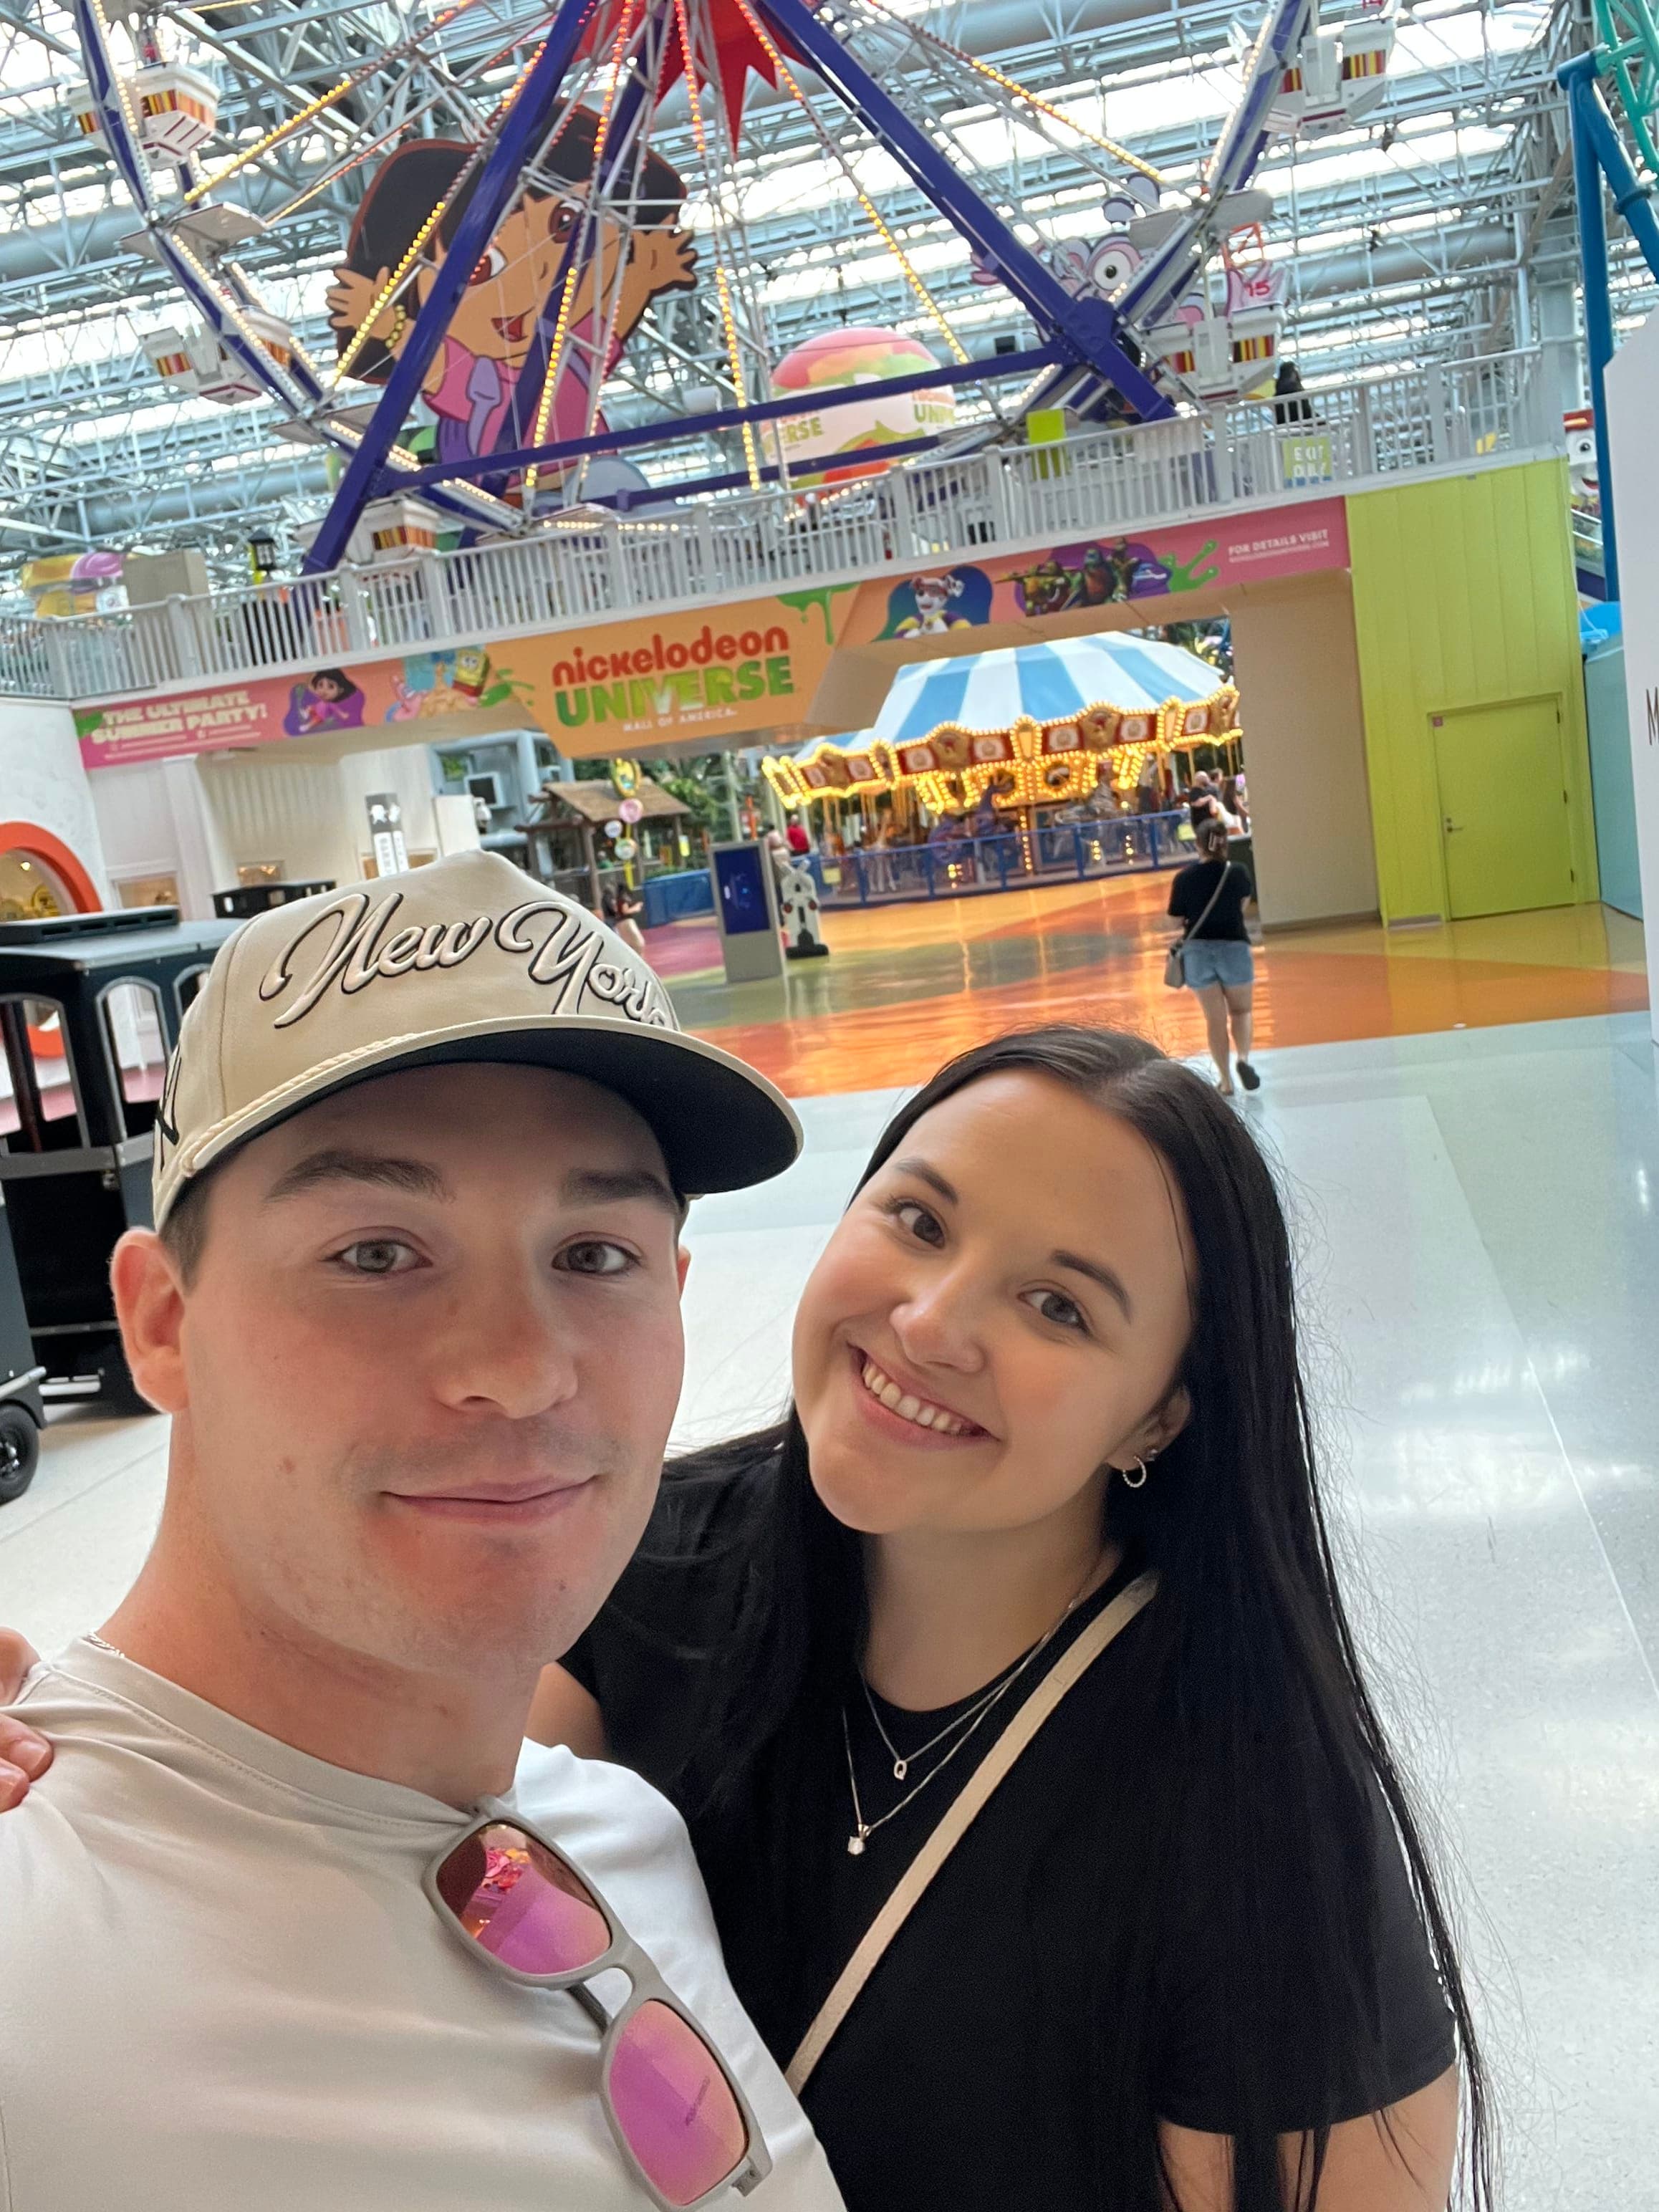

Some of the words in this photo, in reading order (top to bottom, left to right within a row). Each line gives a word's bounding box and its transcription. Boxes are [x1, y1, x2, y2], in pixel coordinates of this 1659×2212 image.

[1244, 279, 1270, 297] 15
[1228, 544, 1250, 557] FOR
[1253, 534, 1297, 551] DETAILS
[1299, 529, 1328, 542] VISIT
[552, 625, 790, 687] nickelodeon
[102, 707, 143, 725] THE
[145, 690, 250, 719] ULTIMATE
[554, 655, 795, 727] UNIVERSE
[91, 718, 184, 744] SUMMER
[186, 703, 268, 730] PARTY!
[623, 720, 653, 732] MALL
[658, 716, 673, 727] OF
[259, 893, 493, 1029] New
